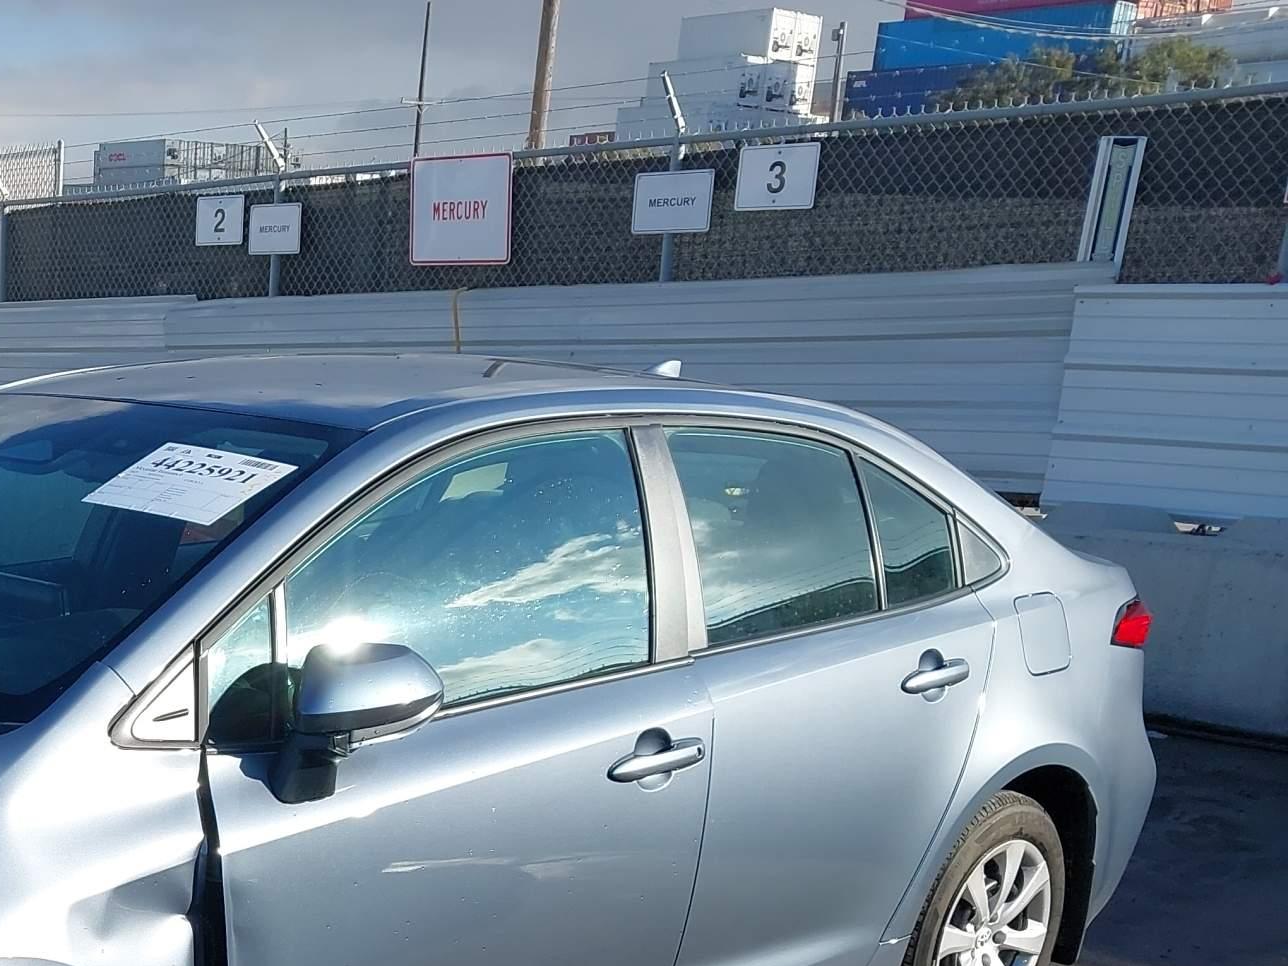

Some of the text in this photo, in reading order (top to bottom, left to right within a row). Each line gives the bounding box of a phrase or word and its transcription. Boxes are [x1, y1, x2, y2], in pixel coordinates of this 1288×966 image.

[766, 160, 787, 194] 3
[432, 199, 488, 221] MERCURY
[648, 196, 697, 208] MERCURY
[213, 208, 226, 233] 2
[259, 223, 290, 233] MERCURY
[151, 456, 257, 484] 44225921
